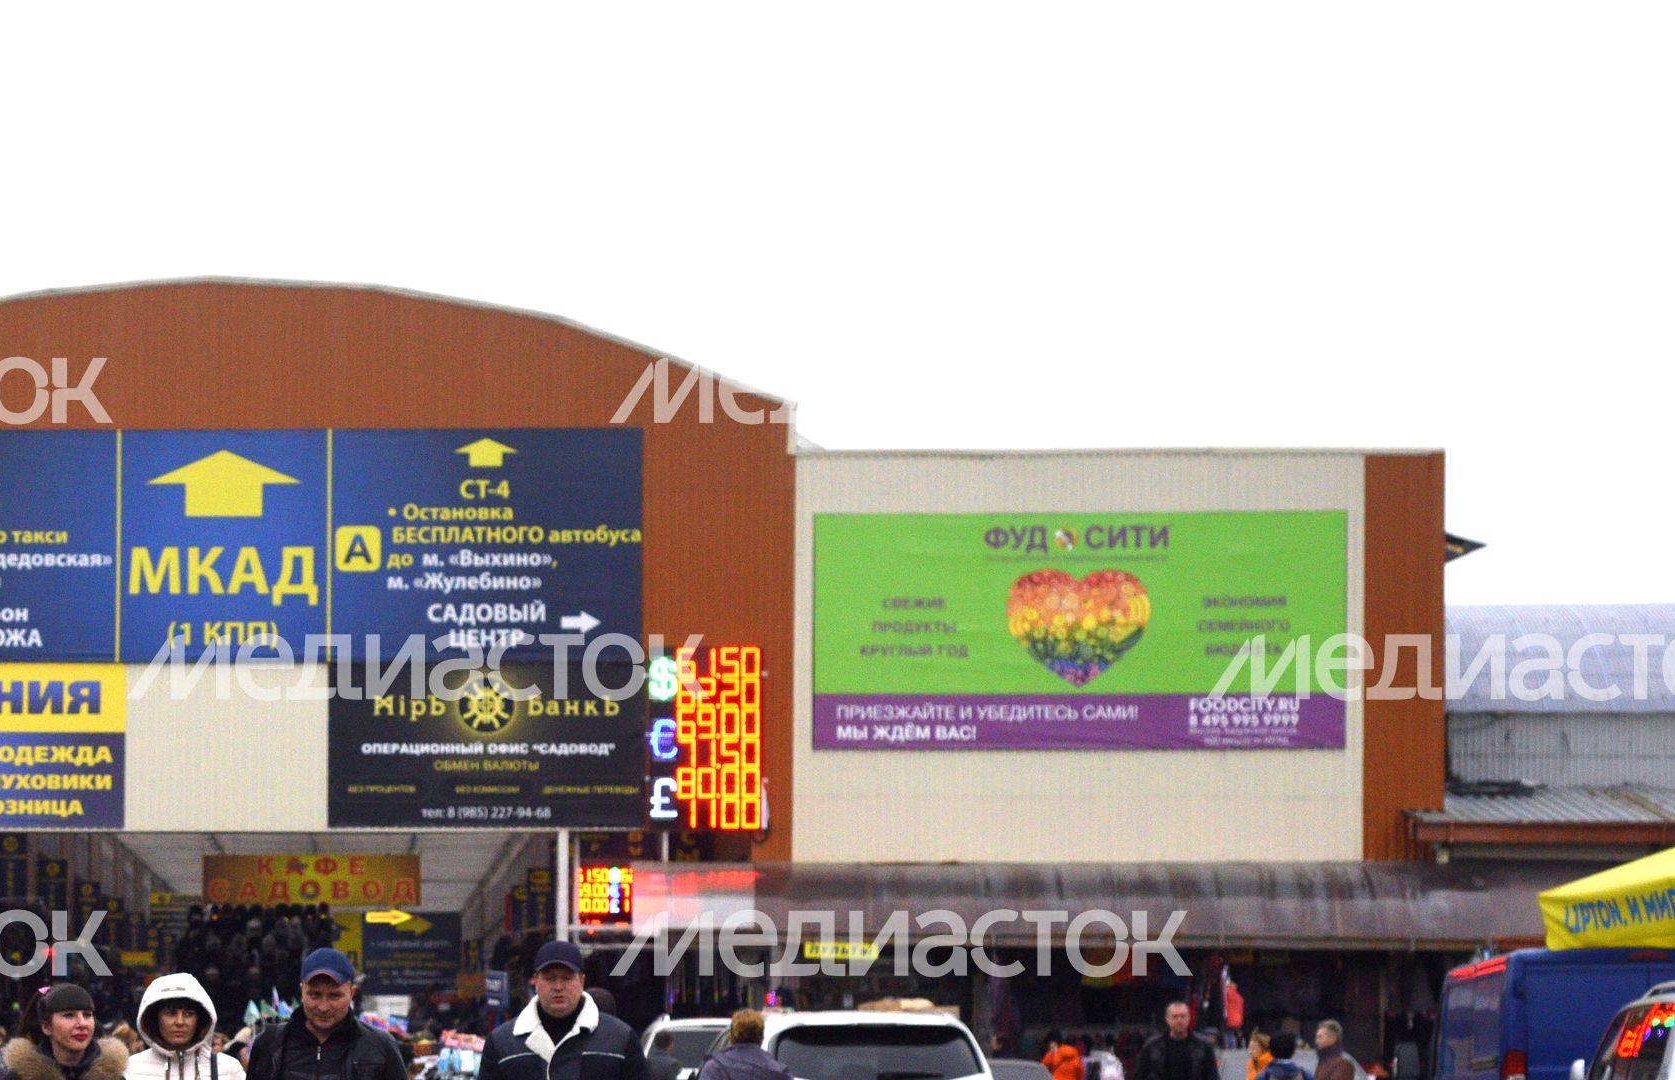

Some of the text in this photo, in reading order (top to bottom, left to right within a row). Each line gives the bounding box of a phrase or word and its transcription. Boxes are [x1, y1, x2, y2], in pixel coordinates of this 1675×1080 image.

[460, 479, 510, 499] СТ-4
[403, 503, 513, 522] Остановка
[11, 531, 68, 543] такси
[392, 526, 641, 546] БЕСПЛАТНОГО автобуса
[984, 525, 1169, 553] ФУД СИТИ
[387, 552, 414, 570] до
[422, 552, 444, 567] м.
[129, 546, 318, 606] МКАД
[387, 573, 542, 593] м. «Жулебино»
[427, 601, 546, 624] САДОВЫЙ
[203, 621, 279, 650] КПП)
[449, 629, 525, 651] ЦЕНТР
[836, 702, 1139, 723] ПРИЕЗЖАЙТЕ И УБЕДИТЕСЬ САМИ!
[836, 722, 977, 743] МЫ ЖДЁМ ВАС!
[361, 741, 484, 756] ОПЕРАЦИОННЫЙ
[488, 743, 529, 756] ОФИС
[434, 761, 540, 772] ОБМЕН ВАЛЮТЫ
[446, 806, 456, 819] 8
[258, 857, 366, 877] КАФЕ
[207, 879, 417, 902] САДОВОД
